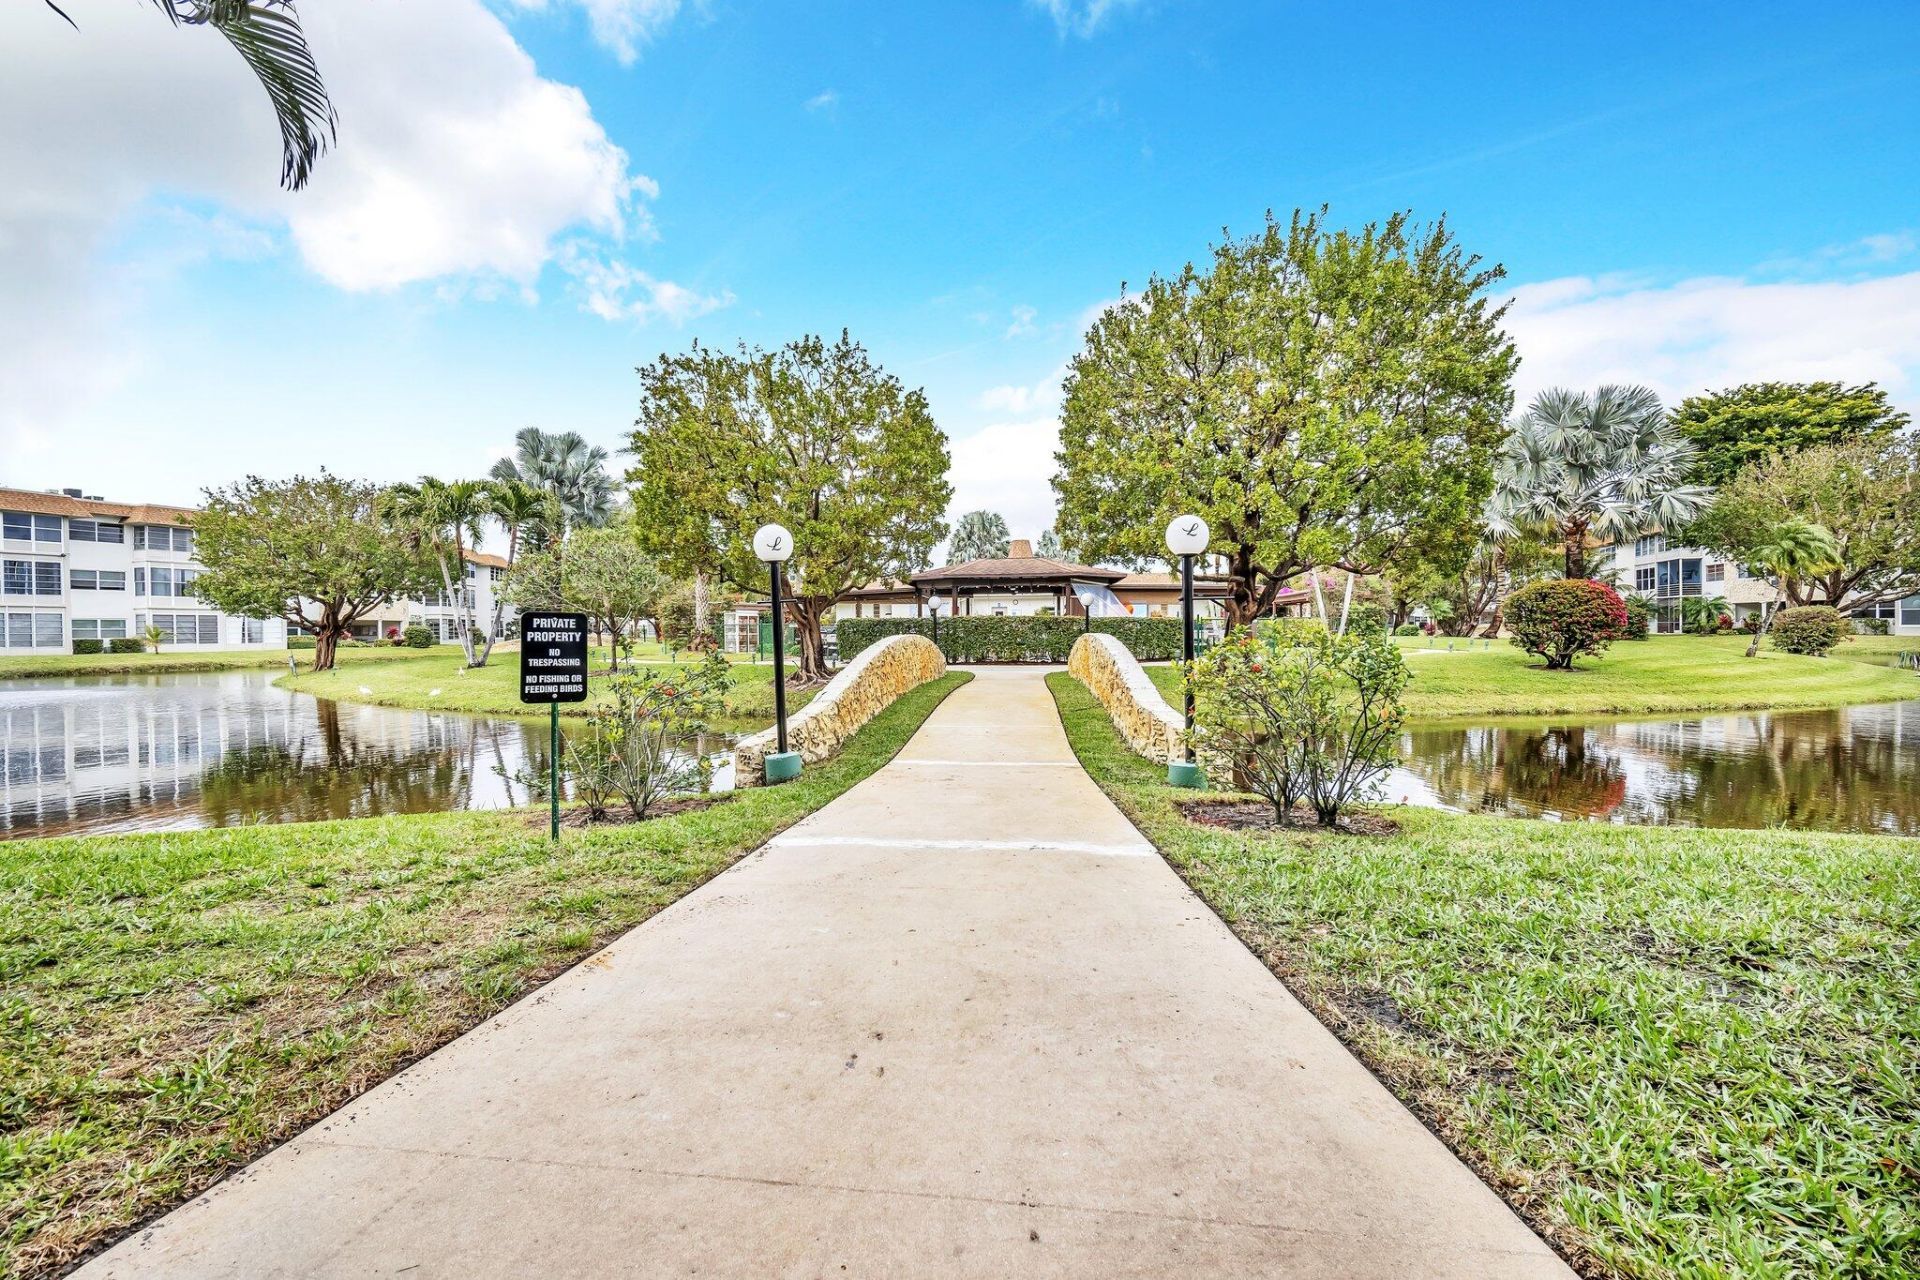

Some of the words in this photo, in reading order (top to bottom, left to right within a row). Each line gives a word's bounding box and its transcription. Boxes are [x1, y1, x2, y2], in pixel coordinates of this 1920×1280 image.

[533, 618, 576, 628] PRIVATE
[527, 632, 581, 642] PROPERTY
[526, 675, 537, 683] NO
[539, 675, 569, 683] FISHING
[525, 685, 558, 693] FEEDING
[560, 685, 583, 693] BIRDS
